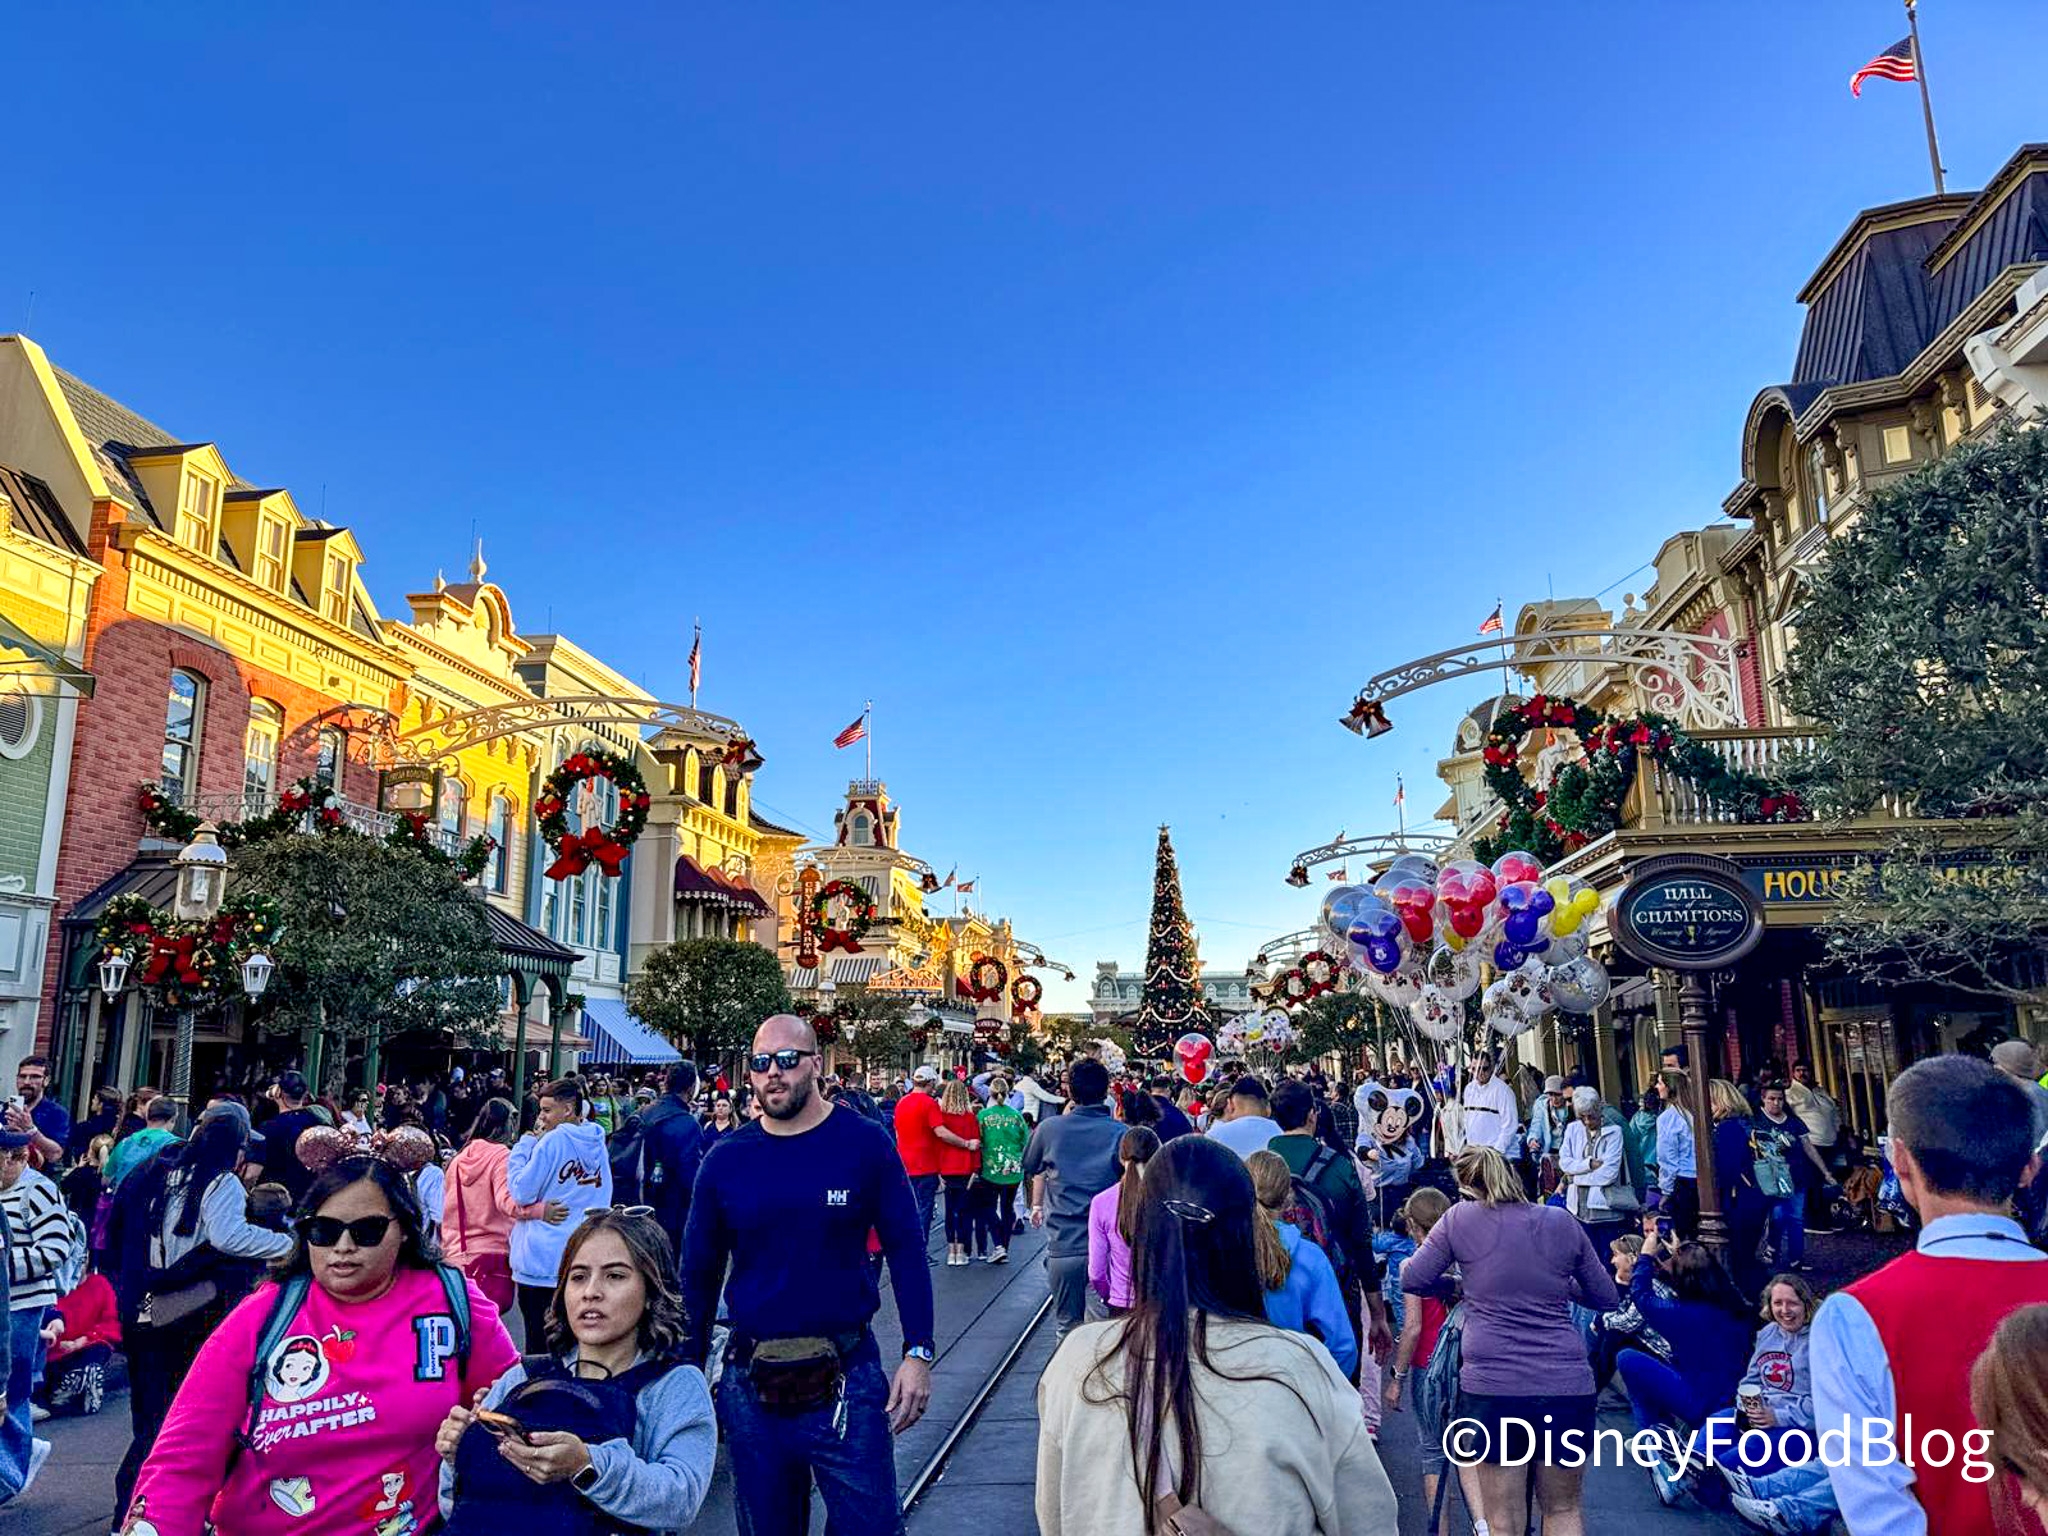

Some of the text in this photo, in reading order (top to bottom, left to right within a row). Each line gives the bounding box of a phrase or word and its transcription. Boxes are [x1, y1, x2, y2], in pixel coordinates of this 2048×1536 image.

[1664, 888, 1712, 900] HALL
[1685, 900, 1694, 909] of
[1636, 909, 1743, 924] CHAMPIONS
[414, 1315, 457, 1380] P
[259, 1392, 359, 1423] HAPPILY
[252, 1406, 376, 1451] Ever AFTER
